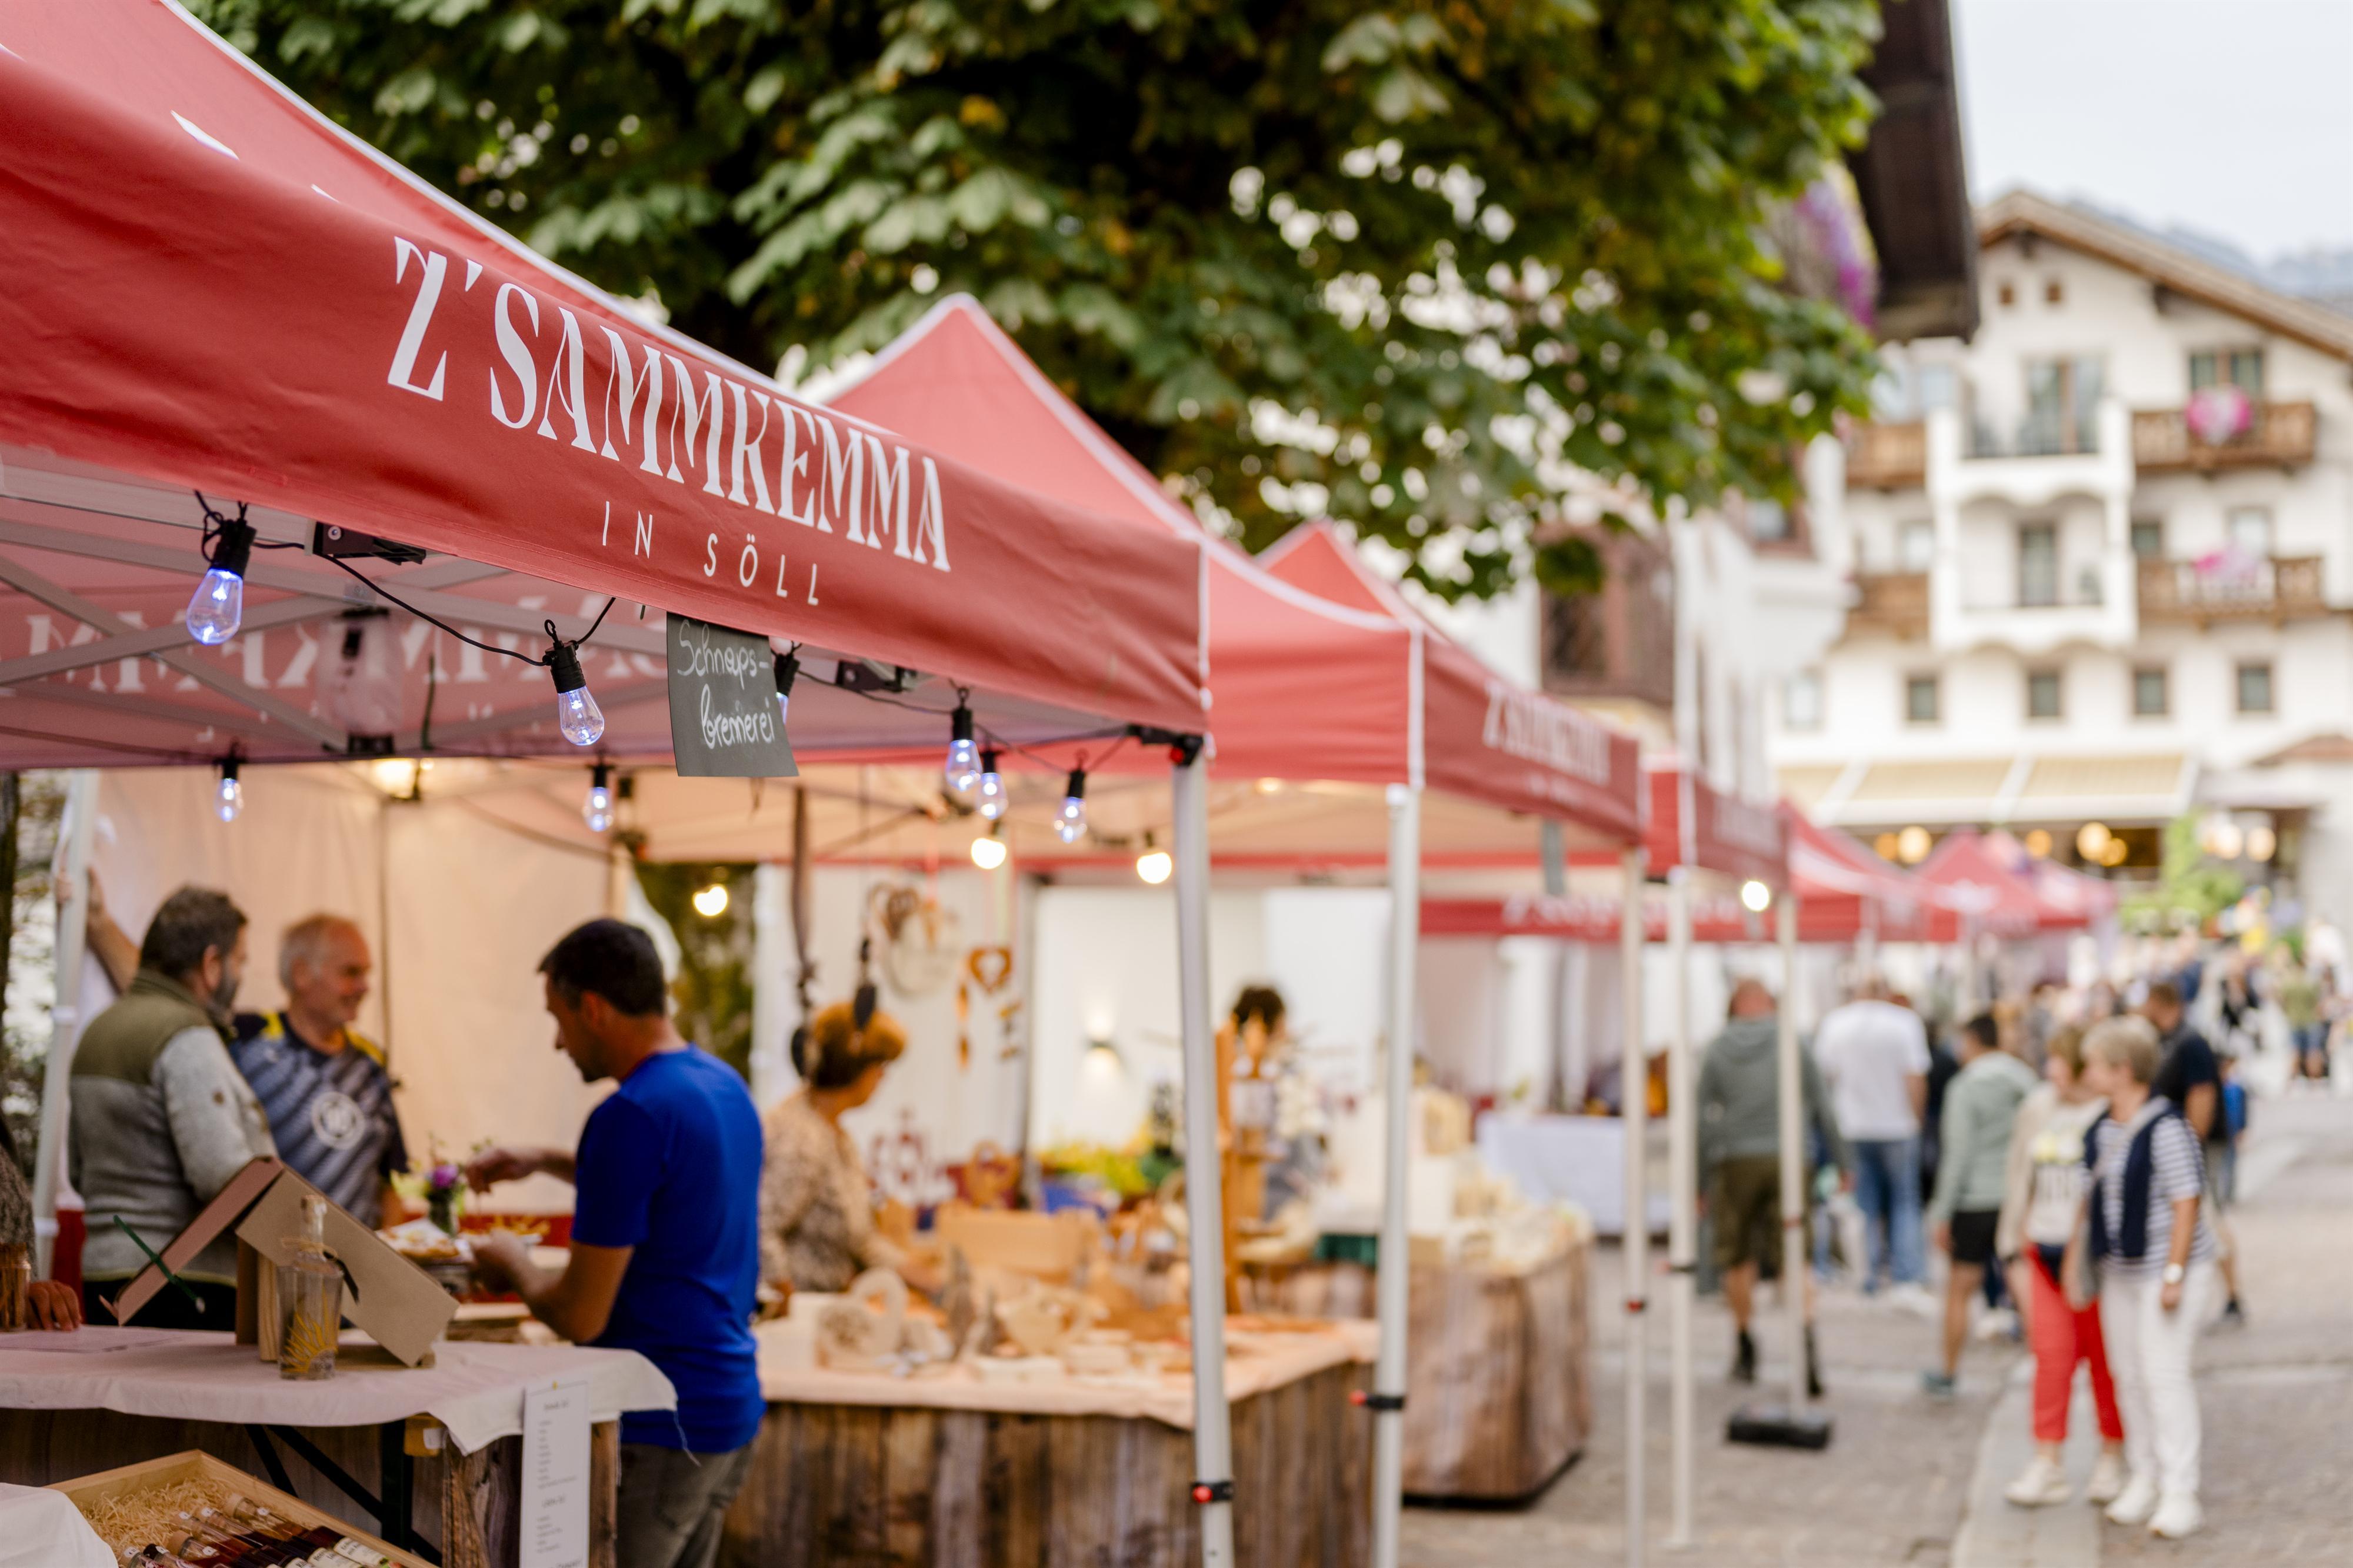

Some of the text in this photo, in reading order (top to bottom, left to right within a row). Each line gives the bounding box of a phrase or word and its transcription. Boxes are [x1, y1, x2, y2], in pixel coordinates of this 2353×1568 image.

[387, 235, 951, 572] Z'SAMMKEMMA
[602, 501, 819, 606] IN SÖLL
